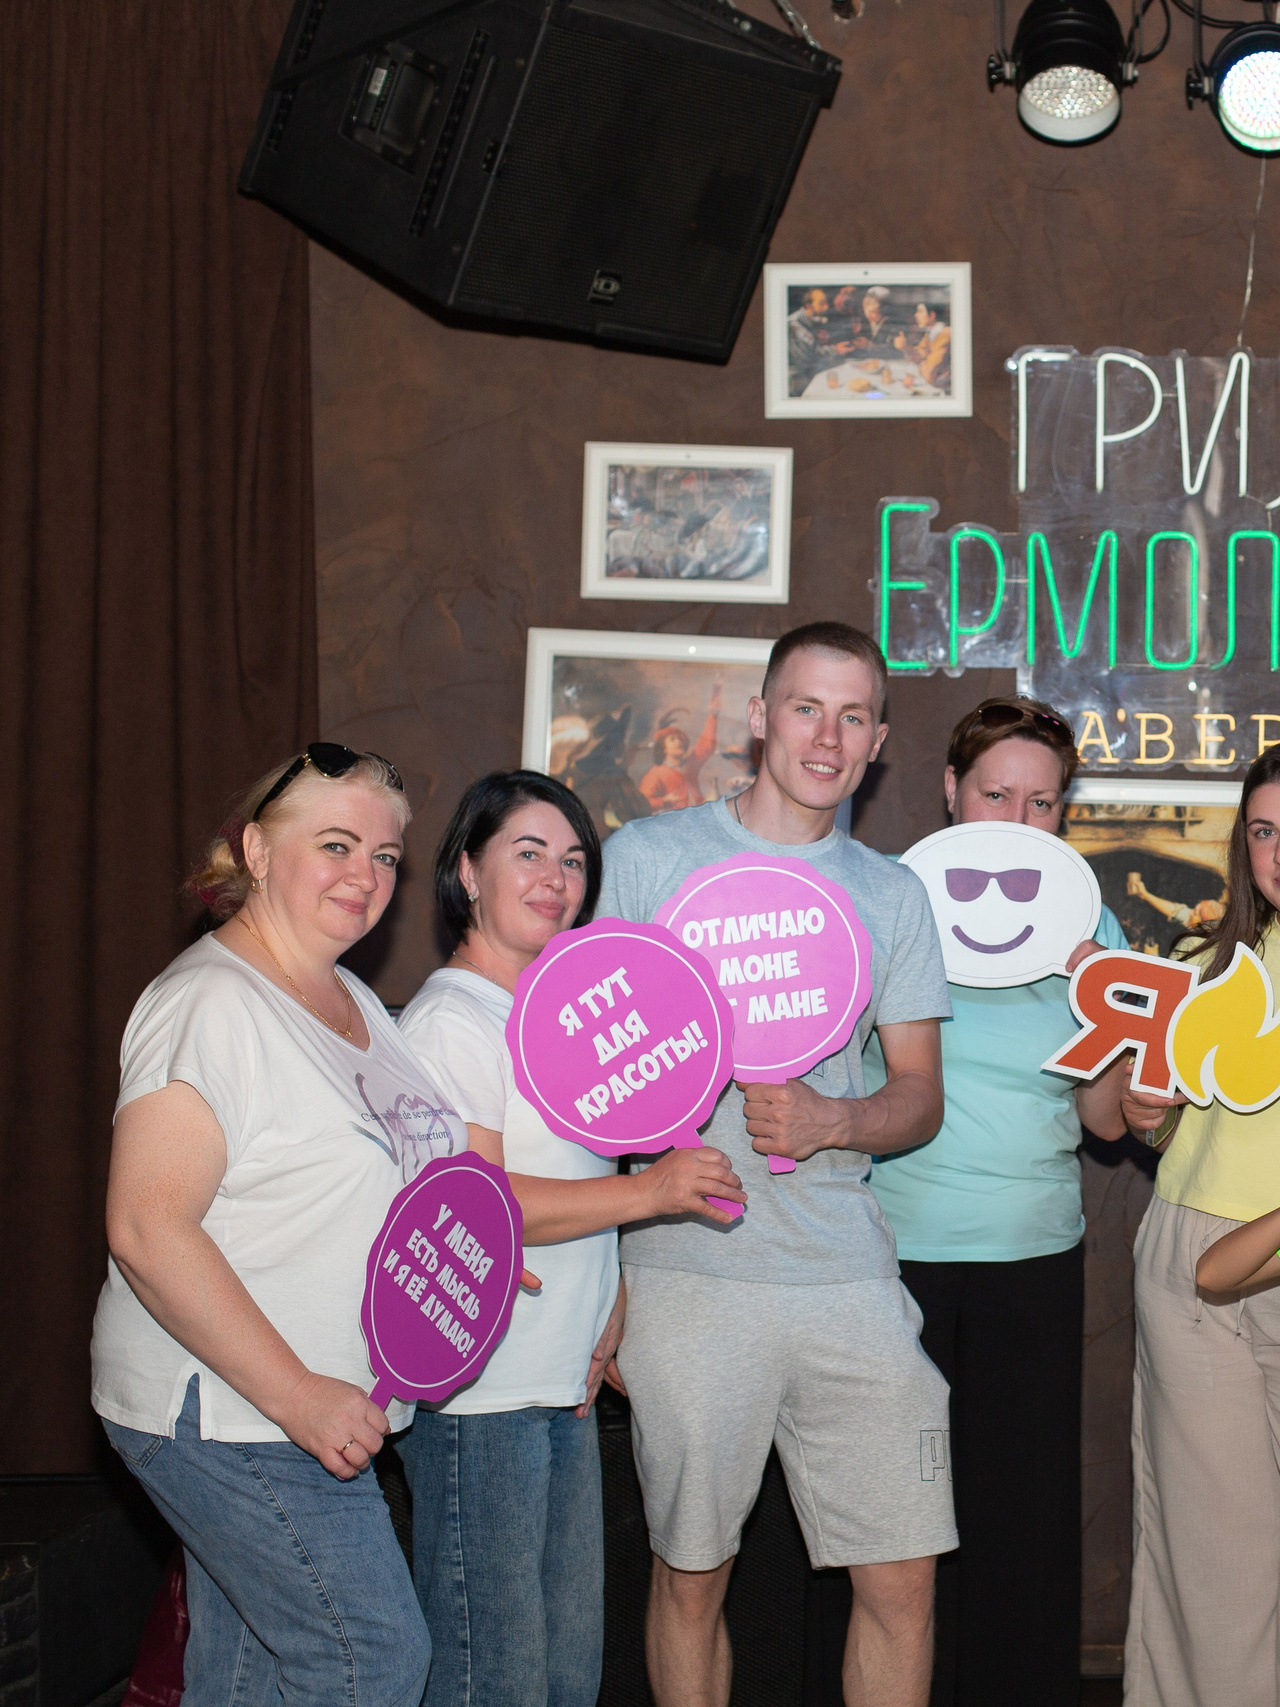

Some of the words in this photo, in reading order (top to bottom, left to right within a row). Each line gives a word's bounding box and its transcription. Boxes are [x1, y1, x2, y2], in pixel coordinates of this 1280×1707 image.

[682, 906, 825, 949] ОТЛИЧАЮ
[558, 1003, 584, 1037] Я
[577, 966, 633, 1019] ТУТ
[718, 950, 800, 987] МОНЕ
[590, 1009, 649, 1066] ДЛЯ
[747, 988, 828, 1024] МАНЕ
[574, 1020, 708, 1125] КРАСОТЫ!
[406, 1228, 439, 1273] ЕСТЬ
[435, 1264, 480, 1320] МЫСЛЬ
[432, 1203, 453, 1231] У
[444, 1221, 494, 1284] МЕНЯ
[383, 1249, 400, 1273] И
[393, 1265, 411, 1287] Я
[404, 1273, 428, 1303] ЕЁ
[420, 1293, 476, 1358] ДУМАЮ!
